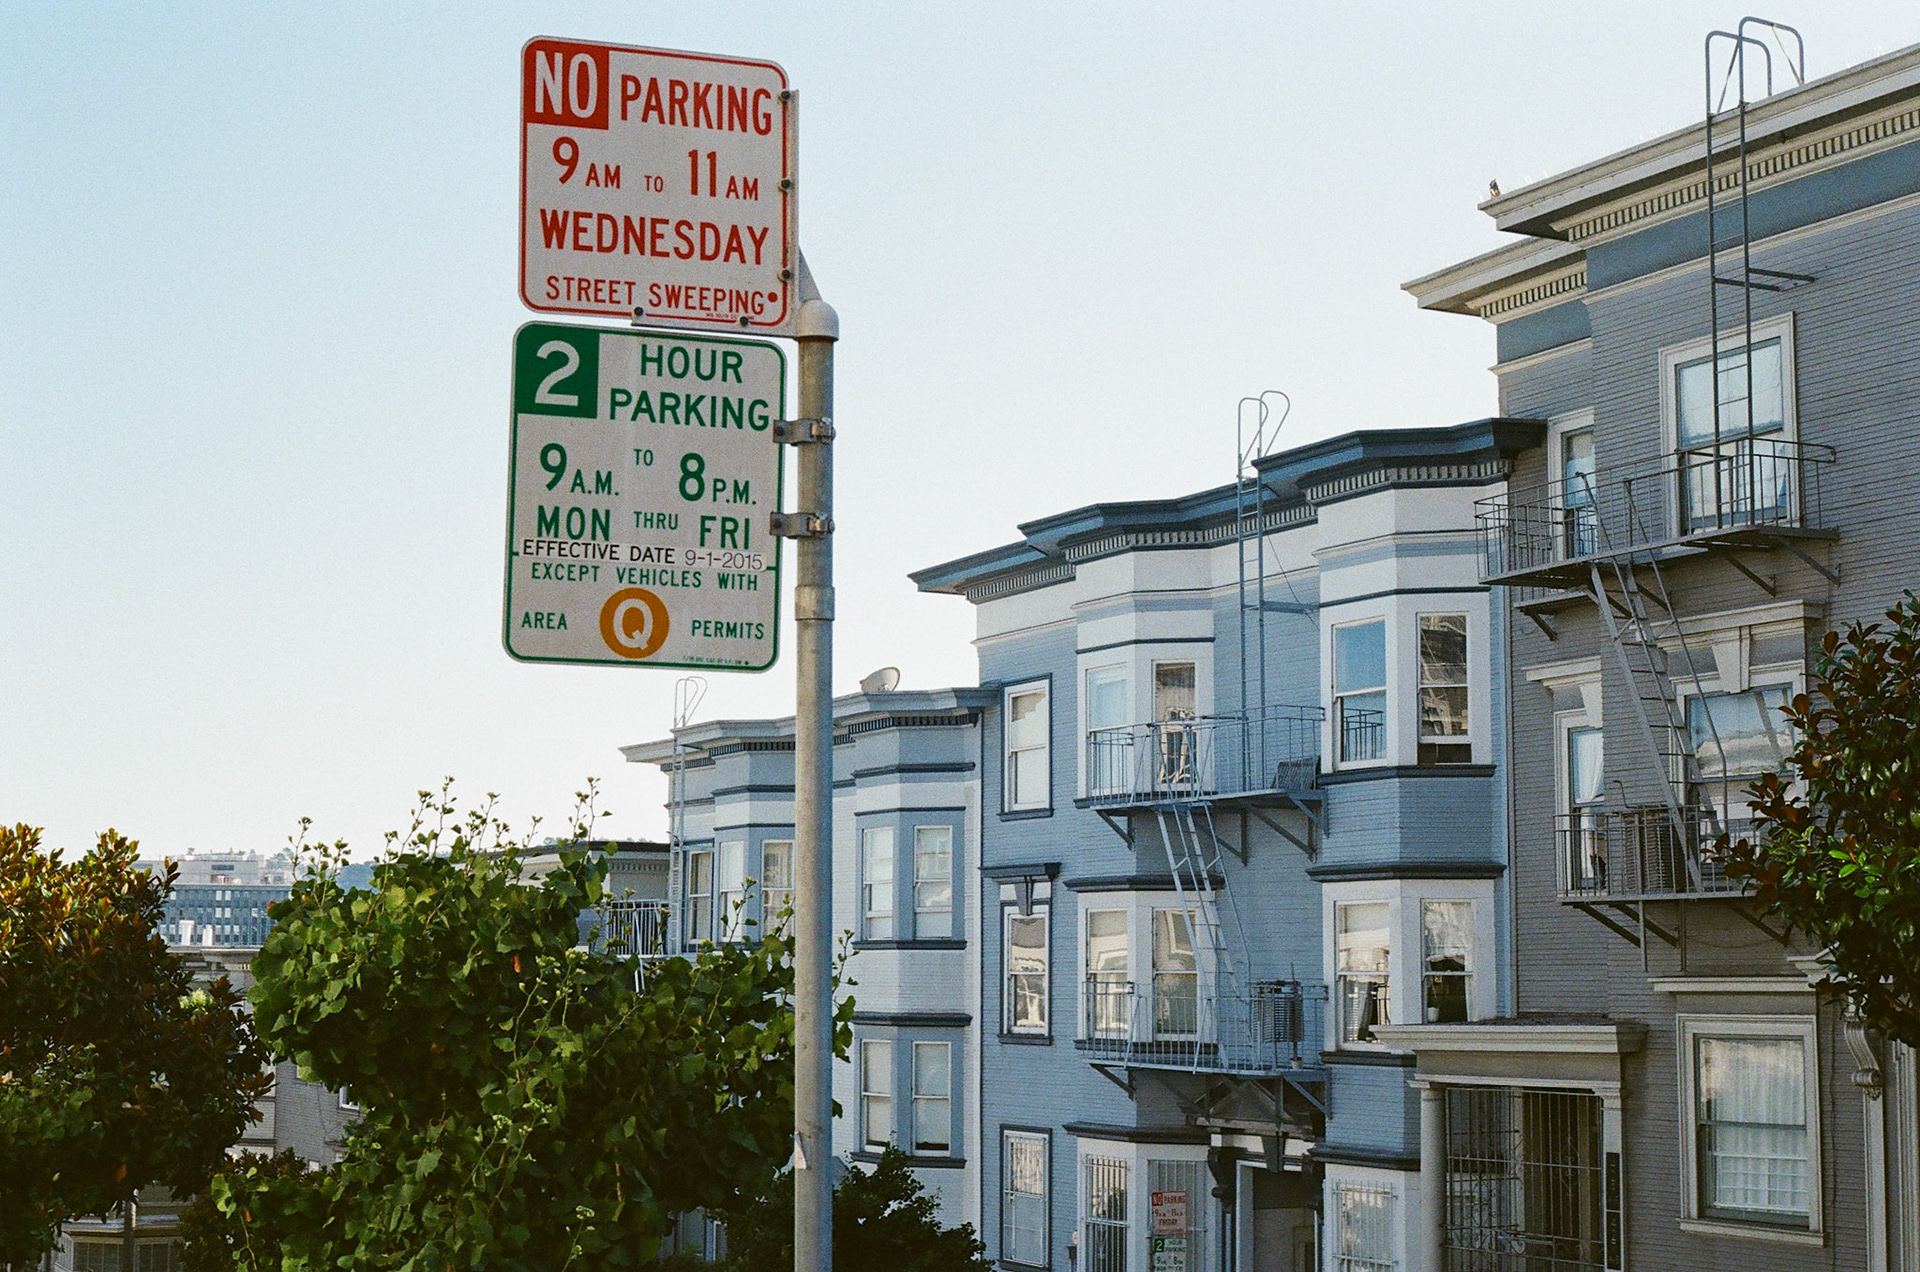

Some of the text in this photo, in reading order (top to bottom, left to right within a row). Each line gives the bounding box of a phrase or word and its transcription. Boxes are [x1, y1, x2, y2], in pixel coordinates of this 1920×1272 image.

[535, 50, 772, 136] NO PARKING
[644, 174, 664, 193] TO
[540, 208, 769, 266] WEDNESDAY
[546, 275, 764, 316] STREET SWEEPING
[534, 340, 744, 407] 2 HOUR
[609, 387, 770, 432] PARKING
[633, 449, 655, 467] TO
[536, 504, 751, 551] MON THRU FRI
[523, 539, 763, 571] EFFECTIVE DATE 9-1-2015
[531, 562, 758, 591] EXCEPT VEHICLES WITH
[521, 597, 765, 651] AREA Q PERMITS
[1156, 1240, 1163, 1251] 2
